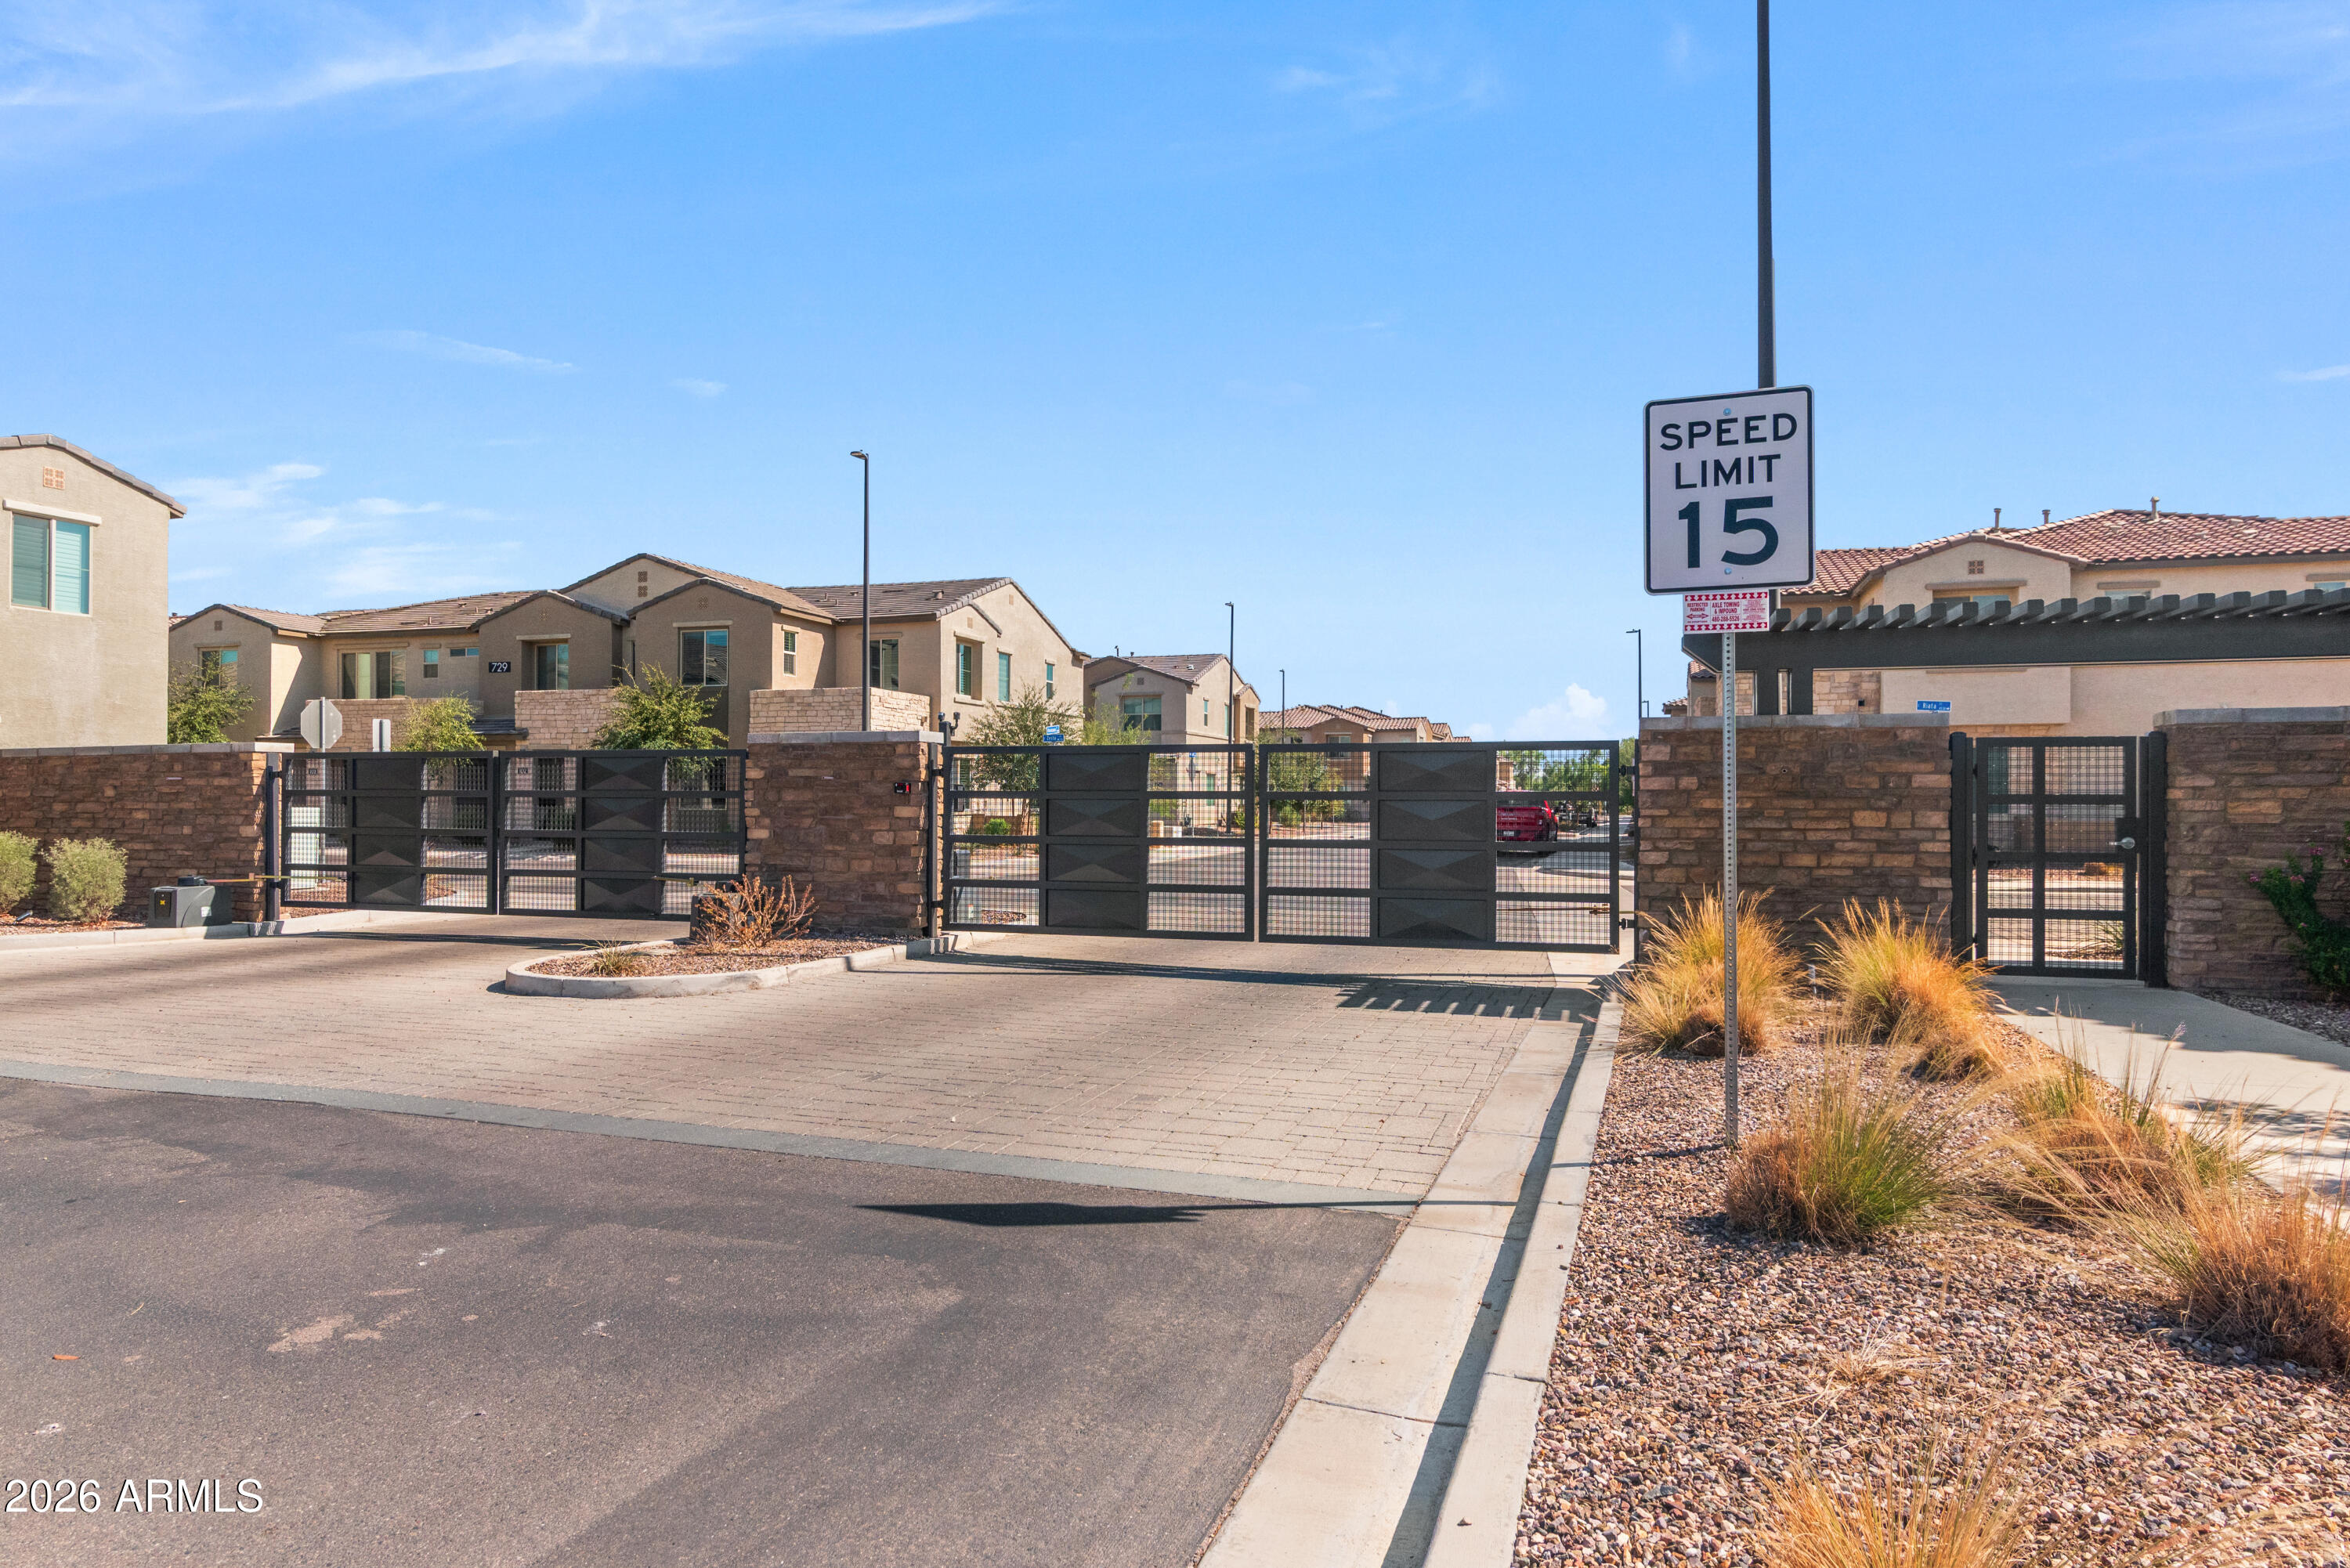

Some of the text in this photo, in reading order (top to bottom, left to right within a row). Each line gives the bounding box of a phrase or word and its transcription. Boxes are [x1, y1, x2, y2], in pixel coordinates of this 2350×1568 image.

[1660, 413, 1798, 451] SPEED
[1675, 453, 1781, 490] LIMIT
[1678, 496, 1779, 569] 15
[491, 662, 508, 672] 729
